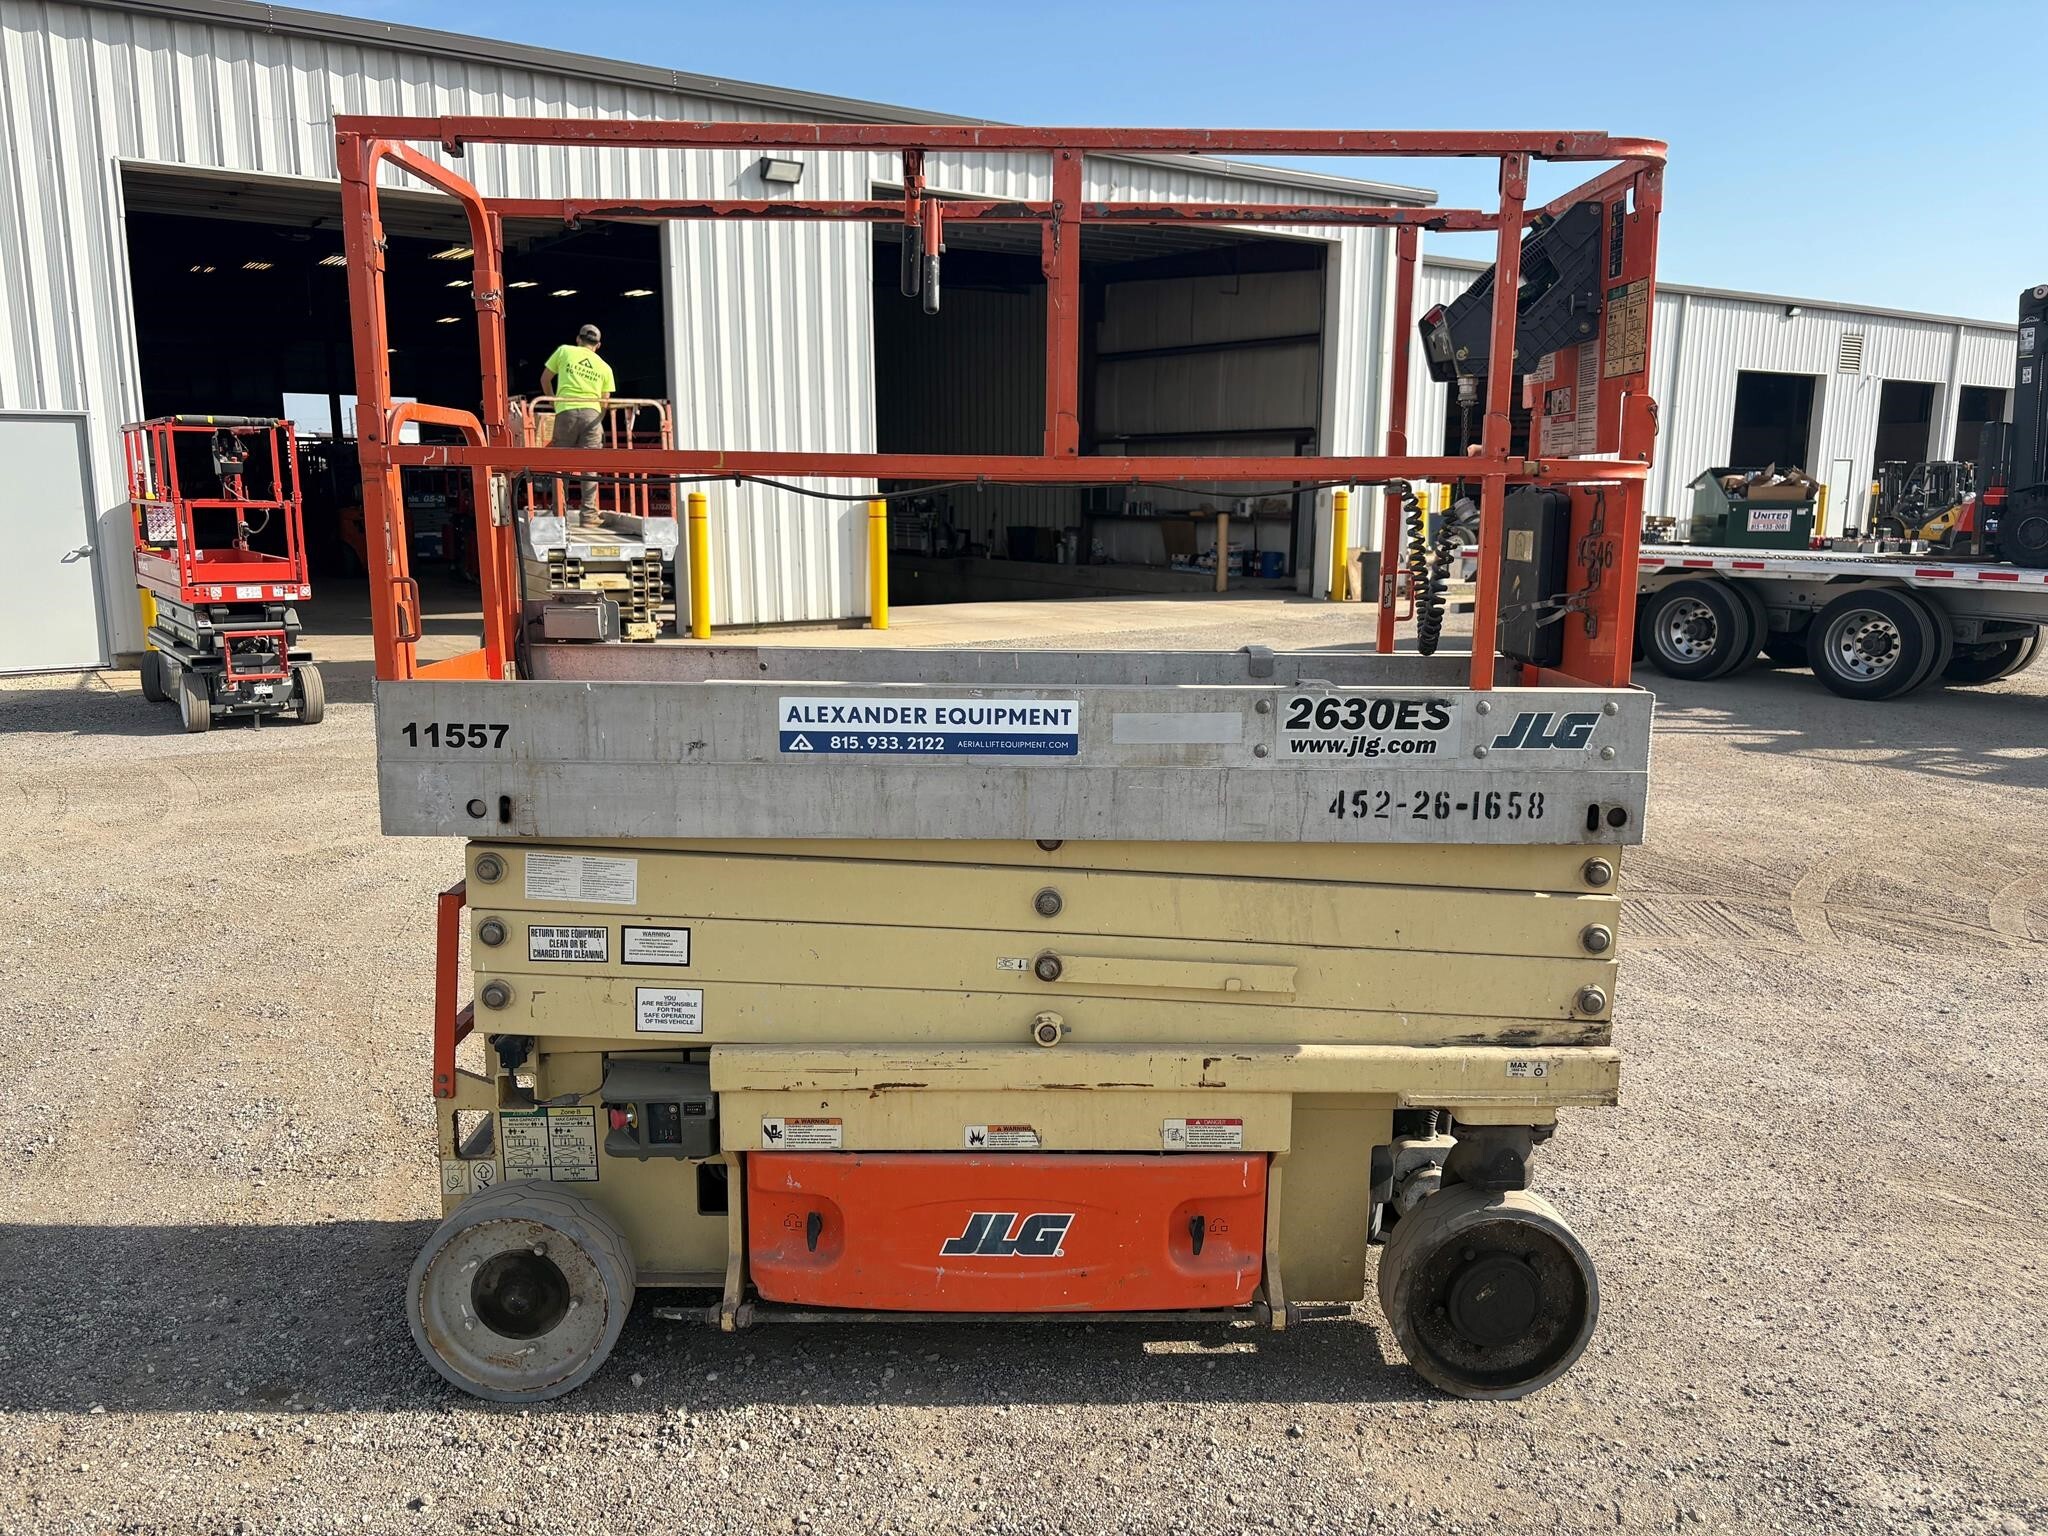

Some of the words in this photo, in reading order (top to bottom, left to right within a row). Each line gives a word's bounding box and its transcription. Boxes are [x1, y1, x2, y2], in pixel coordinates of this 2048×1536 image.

[1753, 511, 1789, 520] UNITED
[786, 705, 928, 724] ALEXANDER
[935, 707, 1072, 726] EQUIPMENT
[1285, 697, 1451, 731] 2630ES
[401, 722, 511, 749] 11557
[1489, 712, 1603, 750] JLG
[1290, 736, 1438, 758] www.jlg.com
[1329, 790, 1545, 820] 452-26-1658
[531, 928, 555, 938] RETURN
[556, 929, 570, 939] THIS
[570, 929, 605, 940] EQUIPMENT
[549, 939, 568, 948] CLEAN
[570, 939, 579, 949] OR
[579, 939, 587, 949] BE
[533, 949, 560, 959] CHARGED
[561, 949, 573, 959] FOR
[574, 950, 604, 960] CLEANING
[939, 1212, 1076, 1256] JLG
